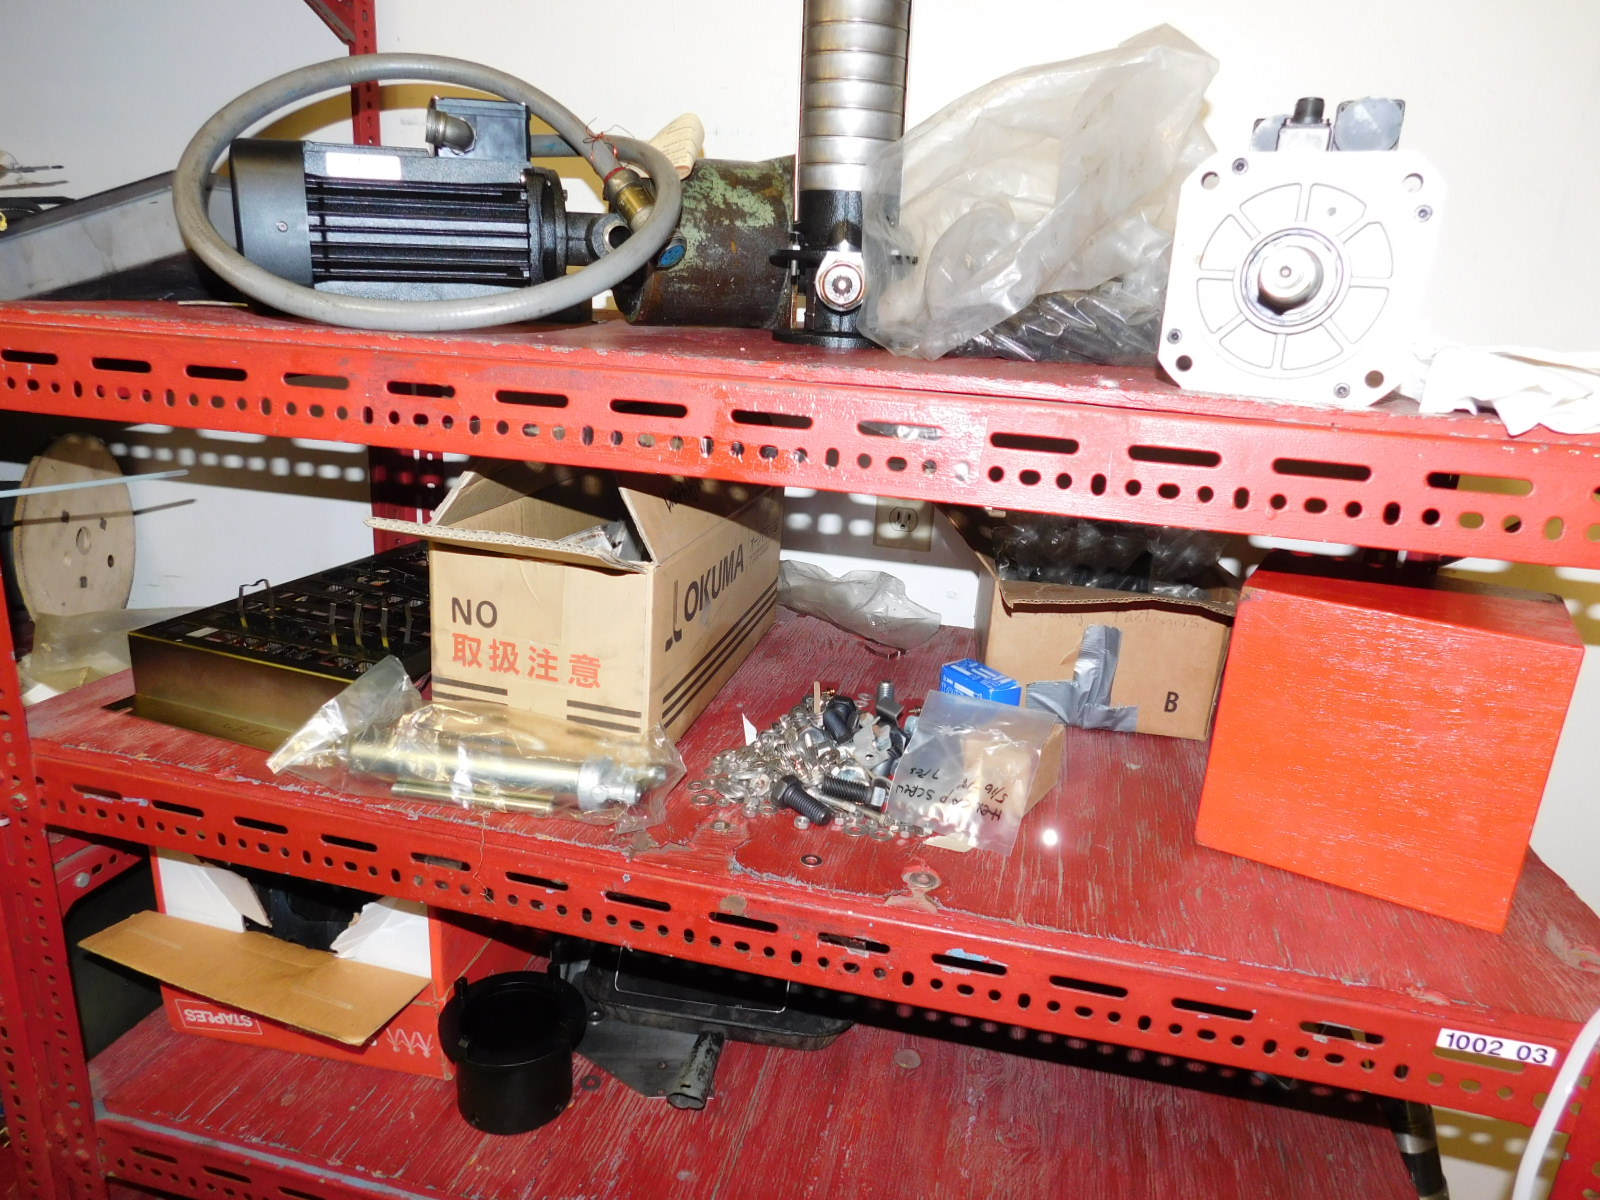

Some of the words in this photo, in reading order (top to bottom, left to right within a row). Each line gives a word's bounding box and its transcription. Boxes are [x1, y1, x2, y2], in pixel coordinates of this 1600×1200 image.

[684, 543, 744, 622] OKUMA
[451, 597, 498, 629] NO
[452, 632, 601, 689] 取扱注意
[1164, 691, 1180, 713] B
[183, 1008, 253, 1028] STAPLES
[1446, 1032, 1504, 1056] 1002
[1516, 1045, 1549, 1064] 03
